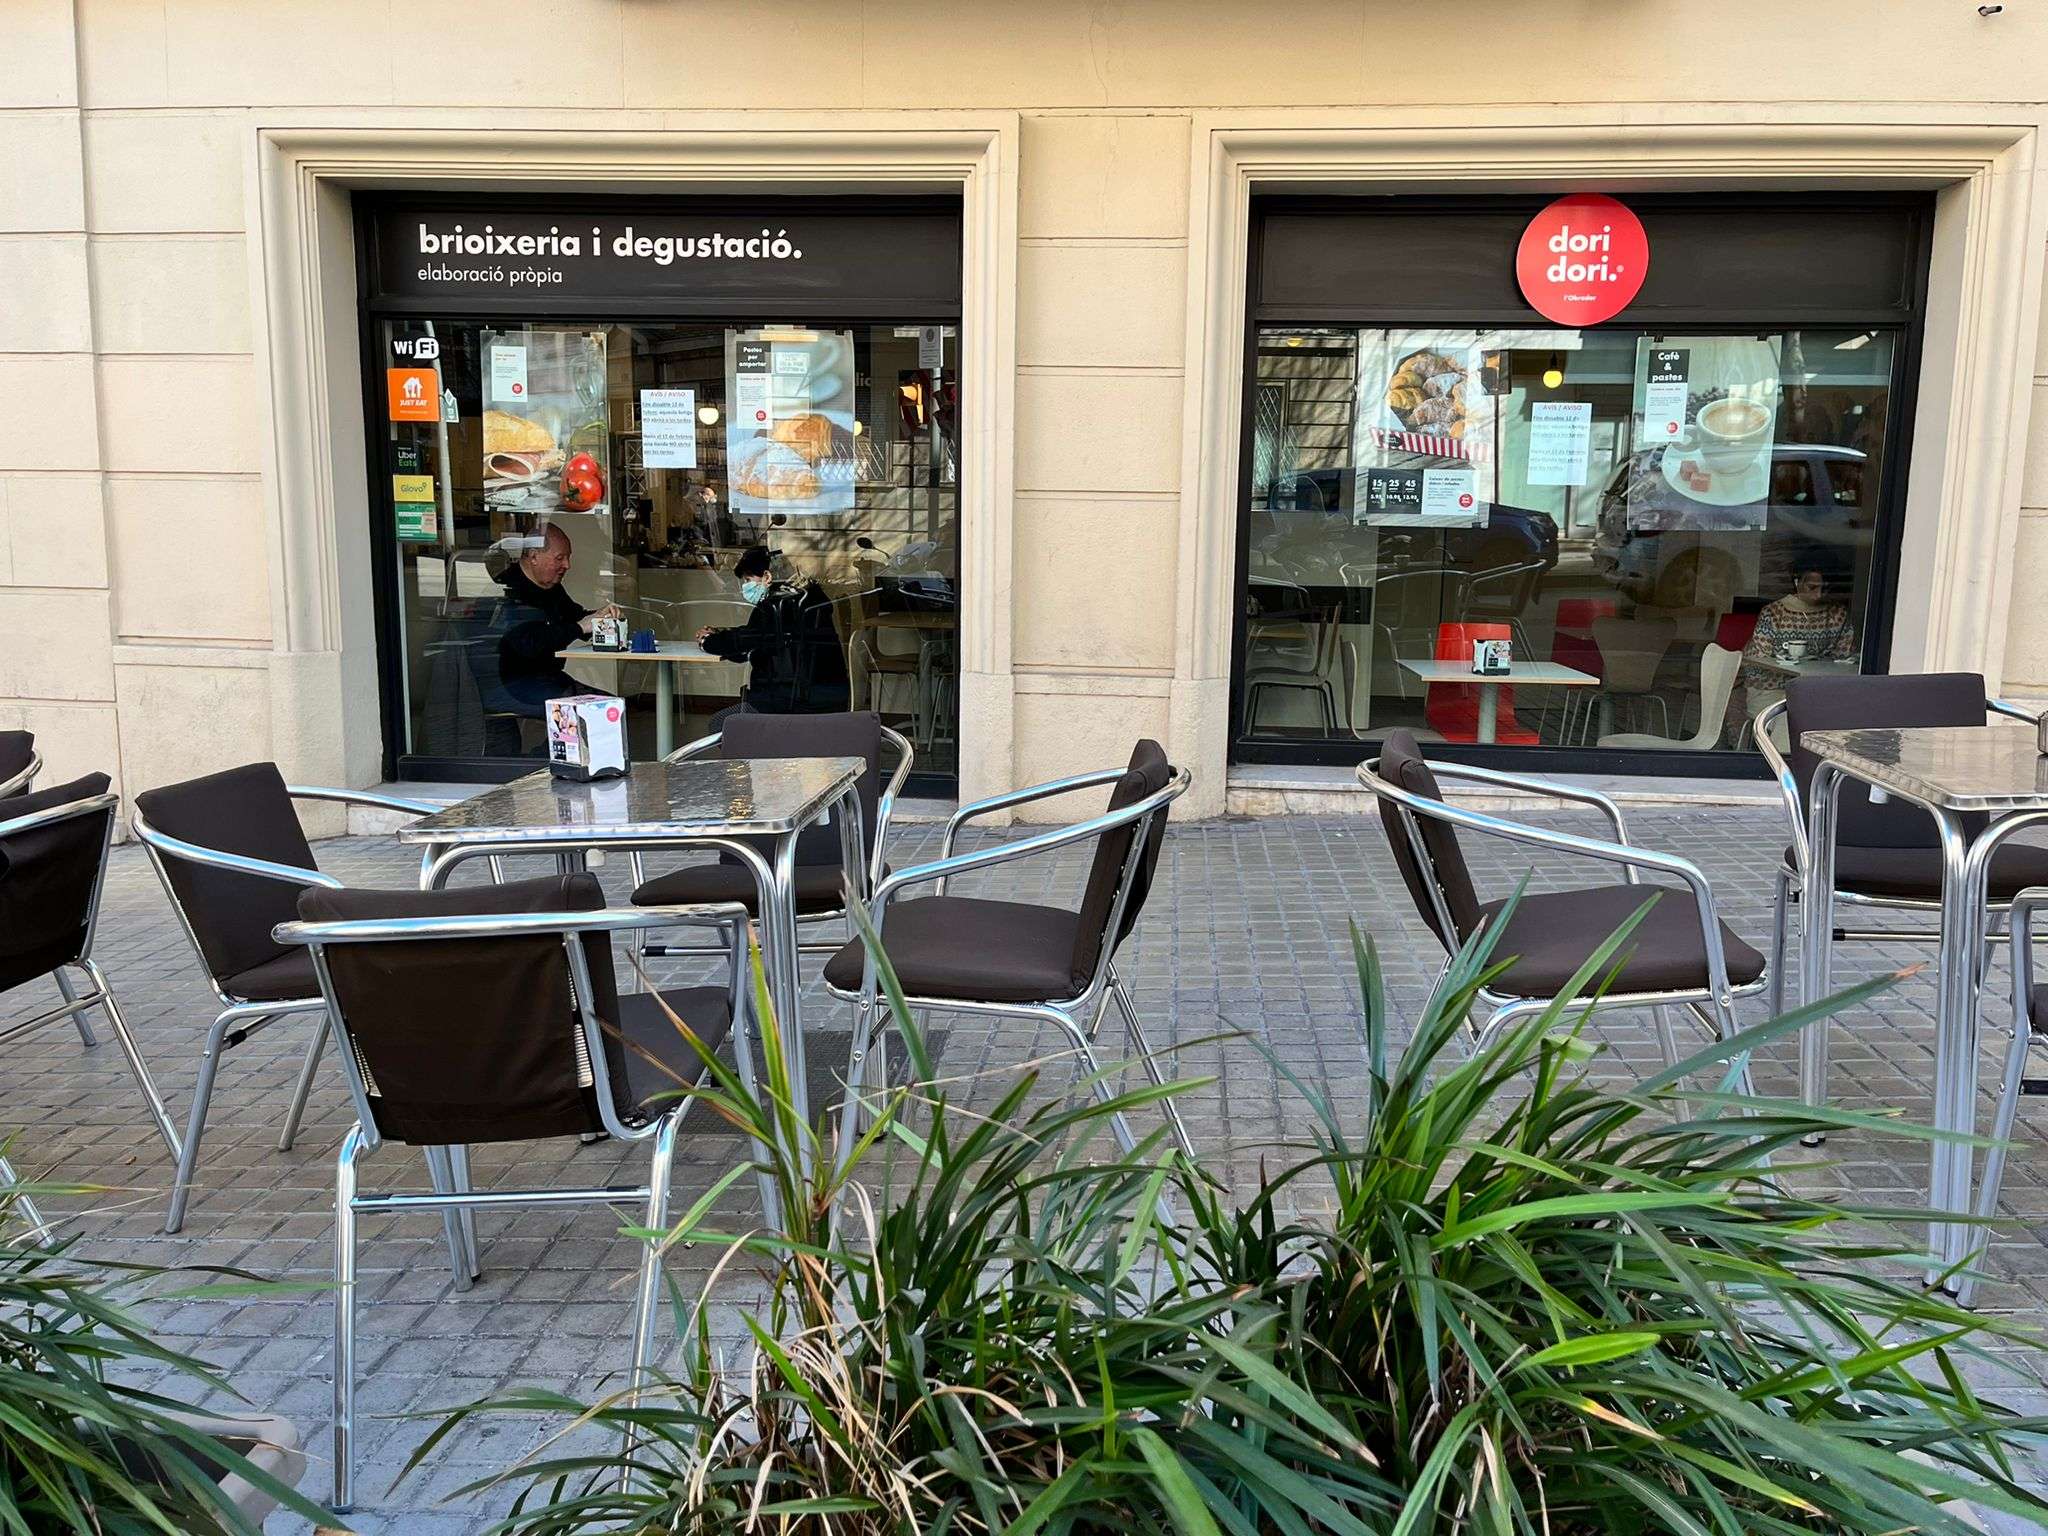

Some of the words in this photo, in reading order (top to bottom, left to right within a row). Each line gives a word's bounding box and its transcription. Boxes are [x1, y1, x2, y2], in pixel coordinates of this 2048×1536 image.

[1548, 225, 1612, 253] dori
[419, 223, 581, 257] brioixeria
[593, 227, 601, 256] i
[612, 226, 803, 266] degustació.
[417, 263, 505, 282] elaboració
[509, 267, 563, 288] pròpia
[1657, 351, 1680, 361] Cafè
[1663, 362, 1672, 371] &
[1652, 374, 1683, 383] pastes
[415, 399, 428, 407] EAT
[398, 450, 417, 459] Uber
[1372, 479, 1383, 487] 15
[1388, 479, 1400, 487] 25
[1404, 479, 1417, 487] 45
